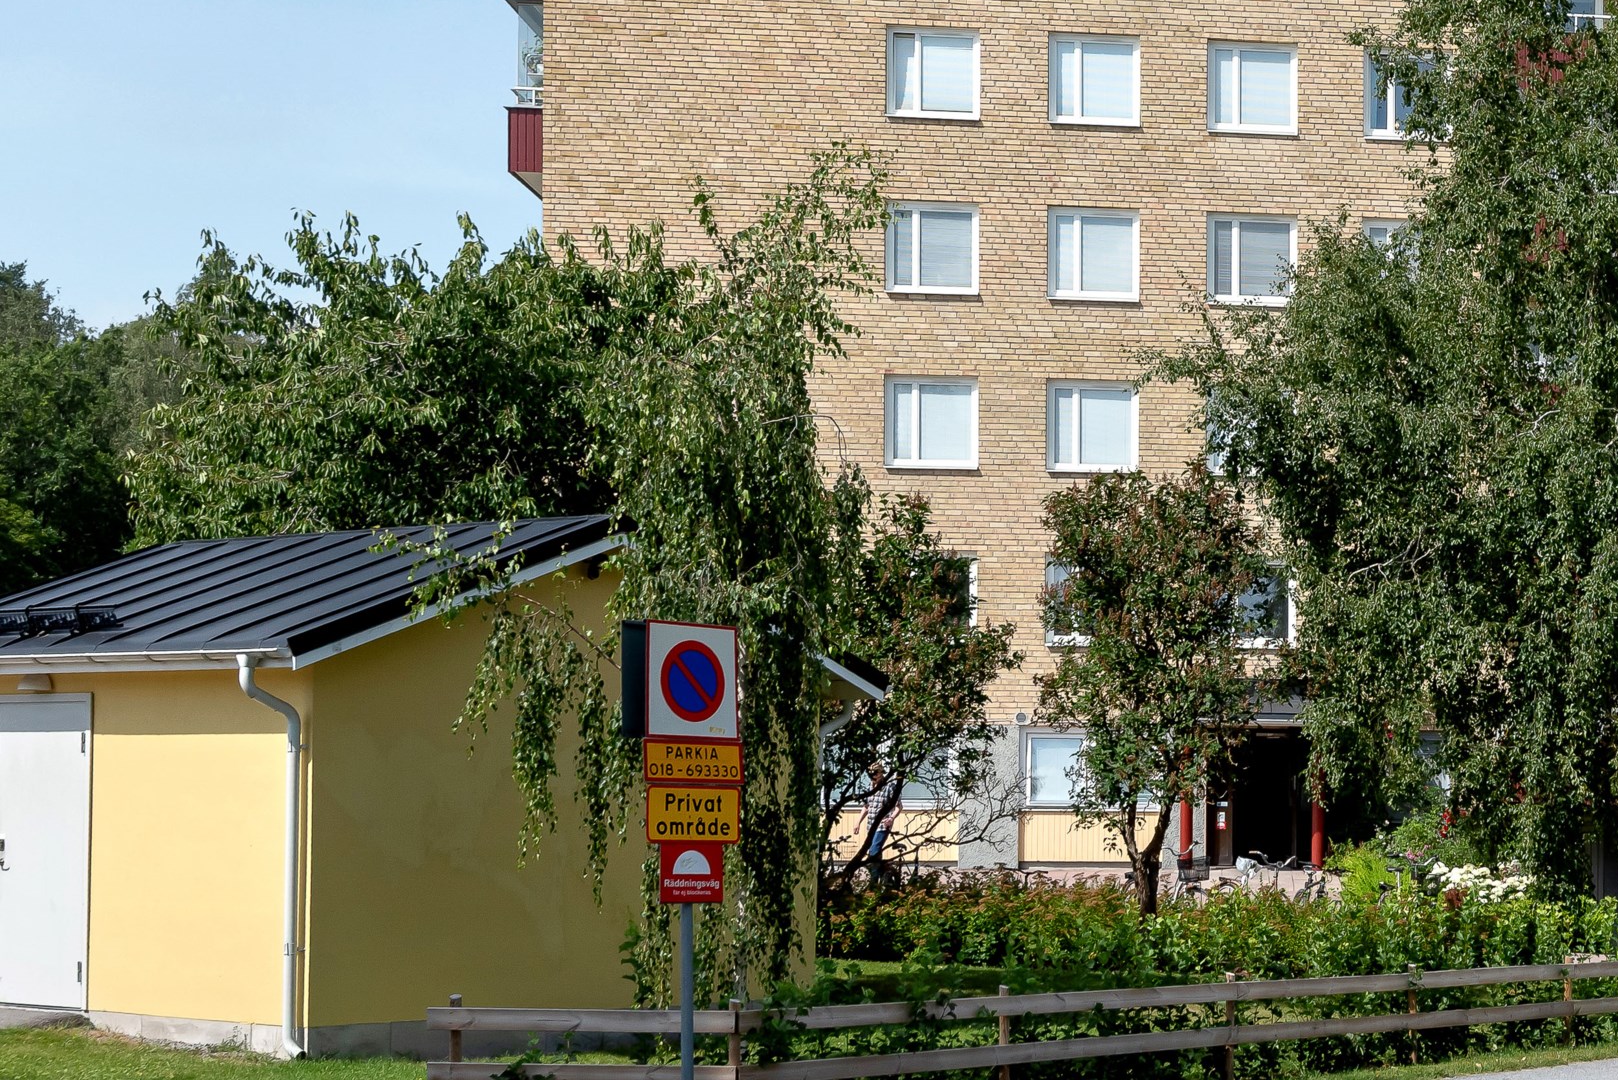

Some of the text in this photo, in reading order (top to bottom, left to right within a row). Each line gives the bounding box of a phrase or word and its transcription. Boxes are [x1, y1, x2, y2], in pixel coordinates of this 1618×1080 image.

[665, 746, 719, 760] PARKIA
[665, 793, 722, 813] Privat
[656, 817, 731, 836] område
[664, 878, 720, 890] Räddningsväg
